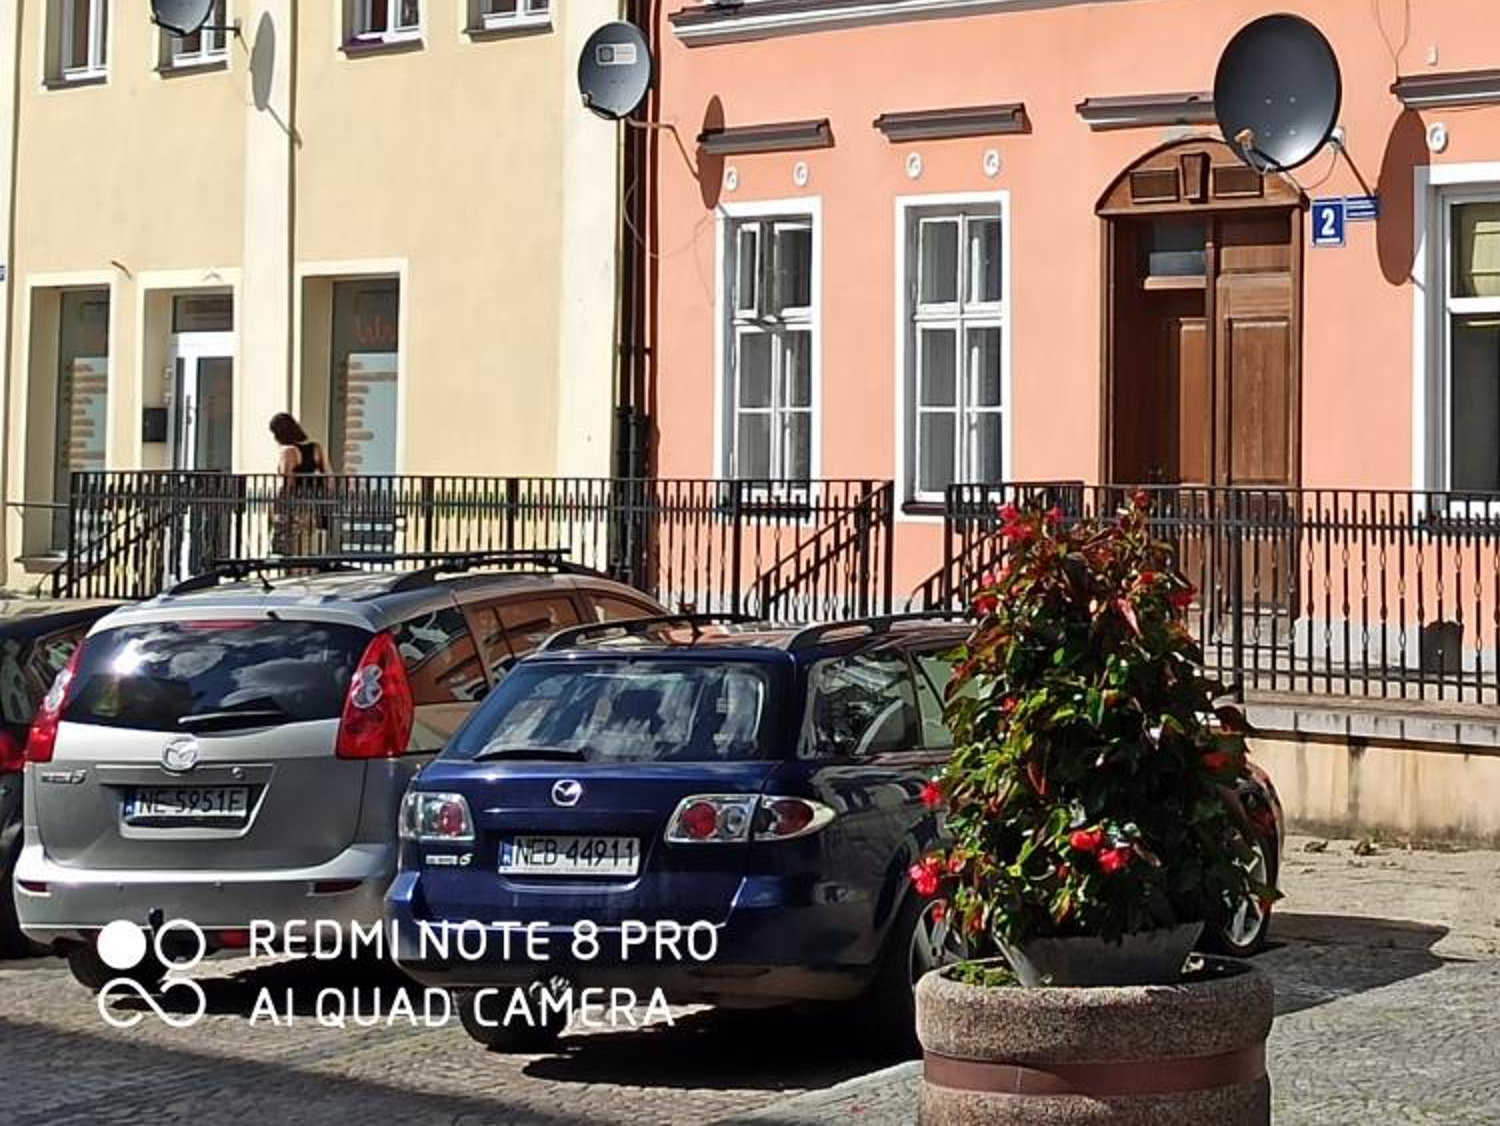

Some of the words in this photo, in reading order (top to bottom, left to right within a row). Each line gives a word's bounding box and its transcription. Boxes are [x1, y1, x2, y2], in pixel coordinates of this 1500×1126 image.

[1321, 207, 1336, 236] 2
[515, 838, 557, 866] NEB
[565, 838, 634, 867] 44911
